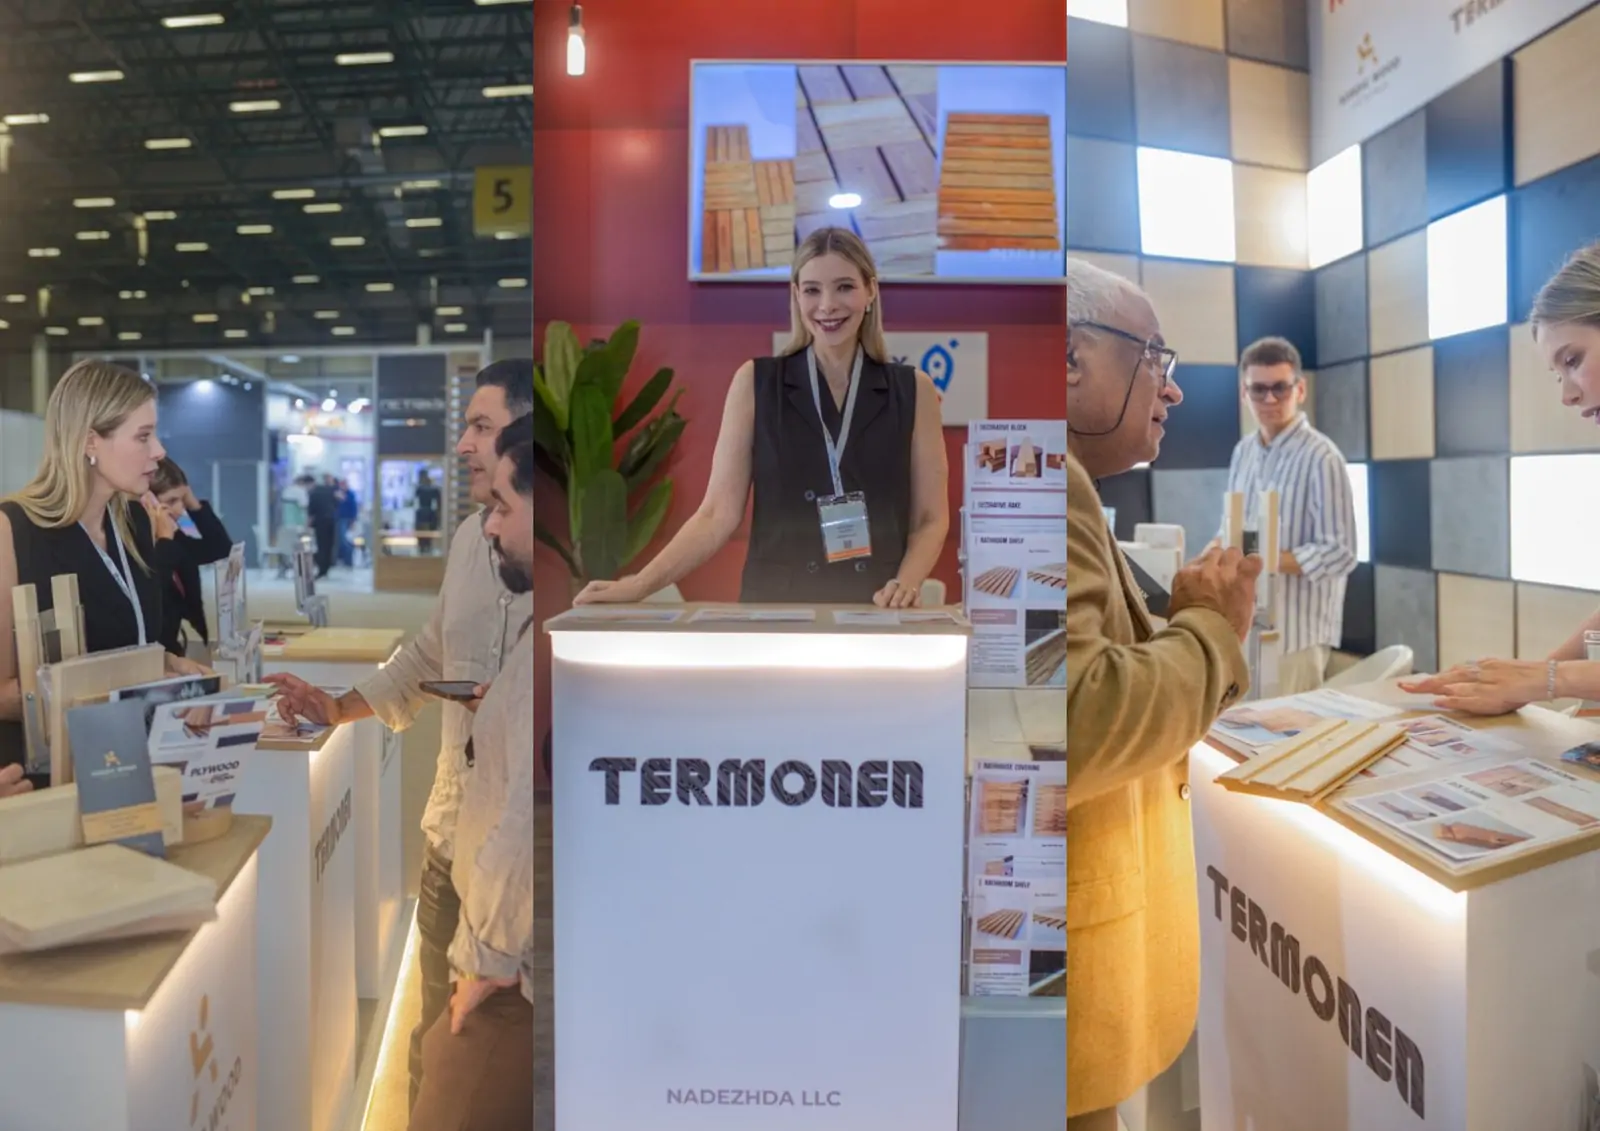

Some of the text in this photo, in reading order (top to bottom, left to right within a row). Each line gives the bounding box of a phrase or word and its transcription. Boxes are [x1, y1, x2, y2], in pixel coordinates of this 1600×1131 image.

[492, 178, 514, 215] 5
[190, 760, 240, 777] PLYWOOD
[588, 756, 925, 808] TERMONEN
[1206, 864, 1426, 1120] TERMONEN
[666, 1088, 842, 1106] NADEZHDA LLC
